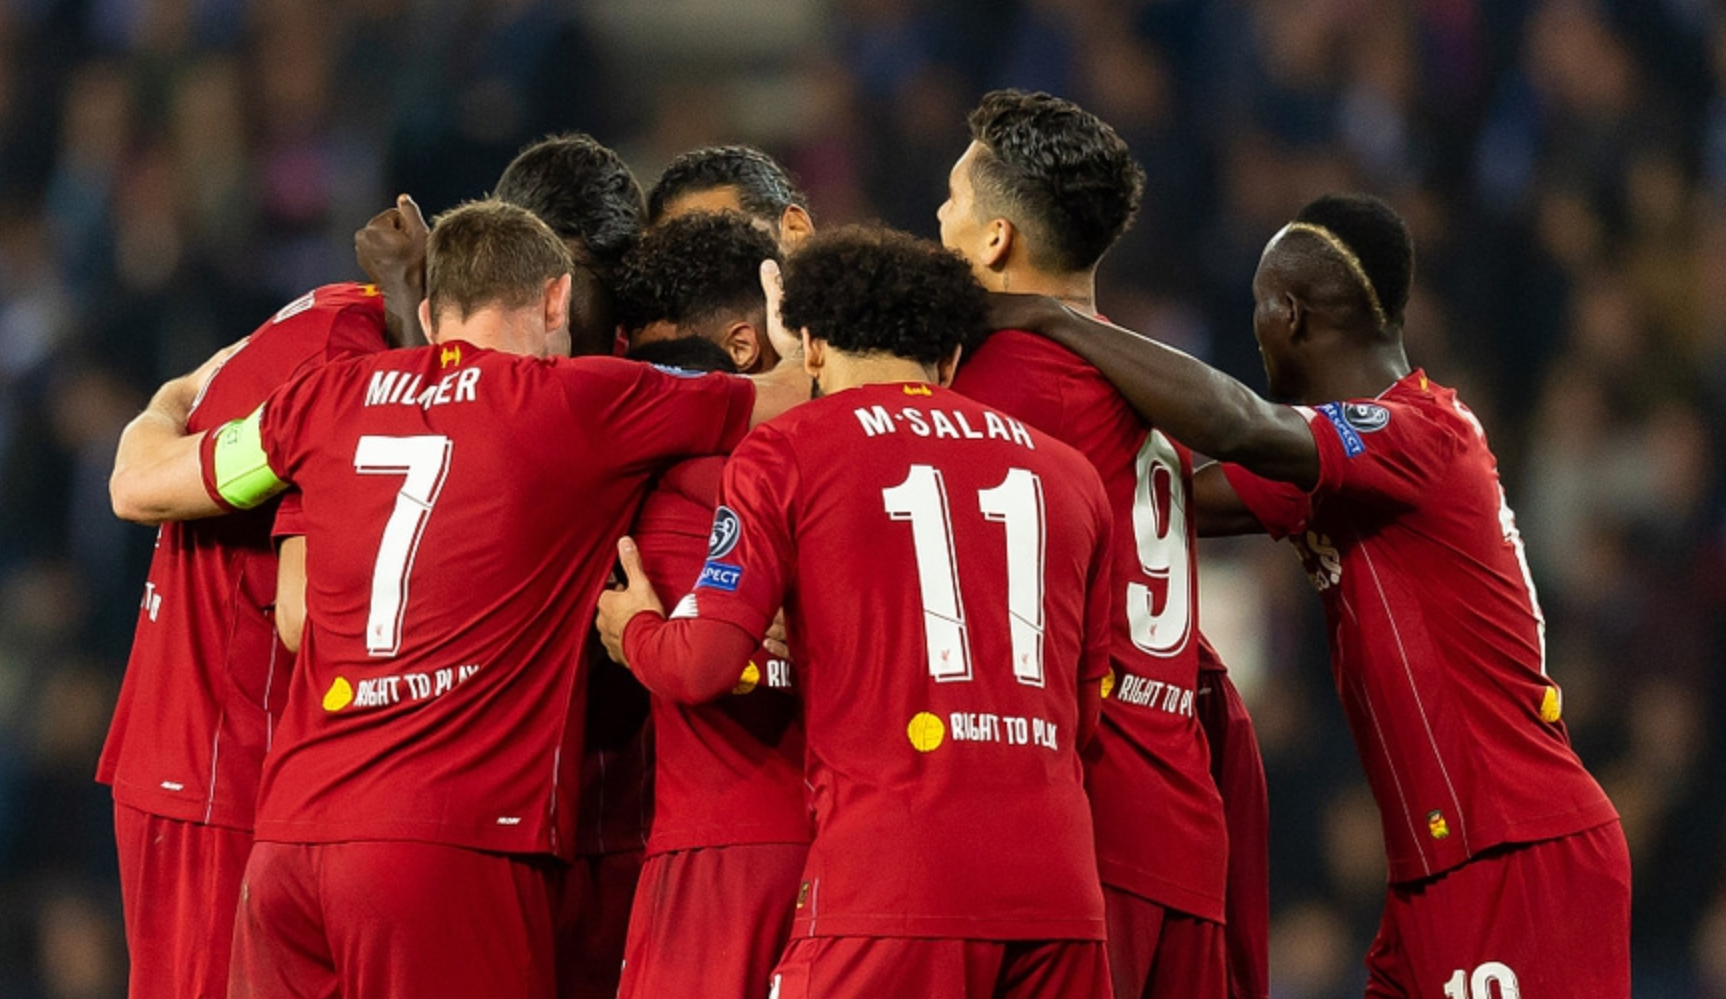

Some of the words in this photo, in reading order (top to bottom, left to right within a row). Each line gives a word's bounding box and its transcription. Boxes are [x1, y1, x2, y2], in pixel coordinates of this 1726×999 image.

[354, 435, 453, 657] 7
[882, 464, 1046, 688] 11
[1126, 428, 1192, 658] 9
[404, 673, 430, 700] TO
[950, 712, 999, 742] RIGHT
[1003, 716, 1028, 745] TO
[1118, 673, 1165, 708] RIGHT
[1162, 684, 1181, 713] TO
